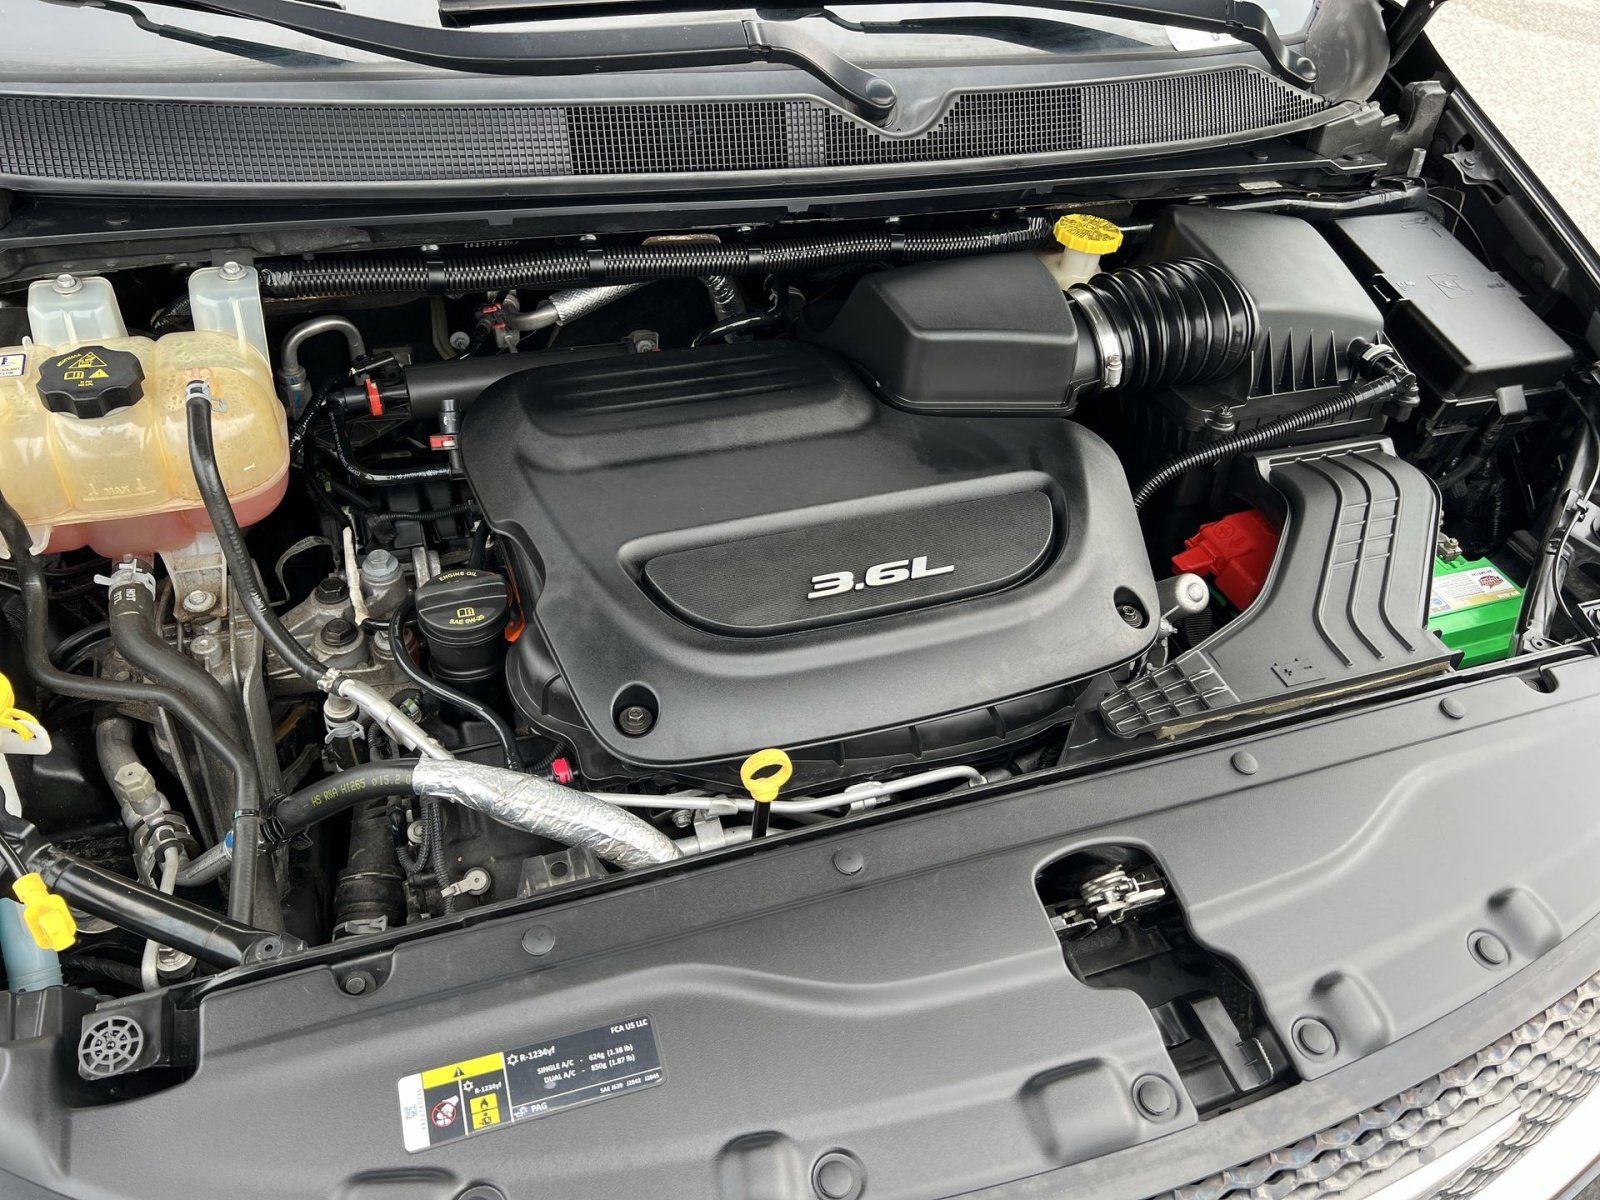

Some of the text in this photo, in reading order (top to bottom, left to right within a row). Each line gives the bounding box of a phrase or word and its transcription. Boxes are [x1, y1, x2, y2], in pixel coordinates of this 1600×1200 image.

[438, 571, 465, 582] ENGINE
[807, 555, 955, 599] 3.6L
[125, 588, 137, 602] HOT
[340, 777, 367, 794] H1265
[610, 1018, 649, 1034] FCA US LLC
[519, 1045, 556, 1062] R-1234yf
[536, 1062, 561, 1075] SINGLE
[561, 1059, 575, 1070] A/C
[543, 1073, 563, 1084] DUAL
[563, 1069, 577, 1079] A/C
[474, 1081, 502, 1094] R-1234yf
[530, 1101, 548, 1114] PAG
